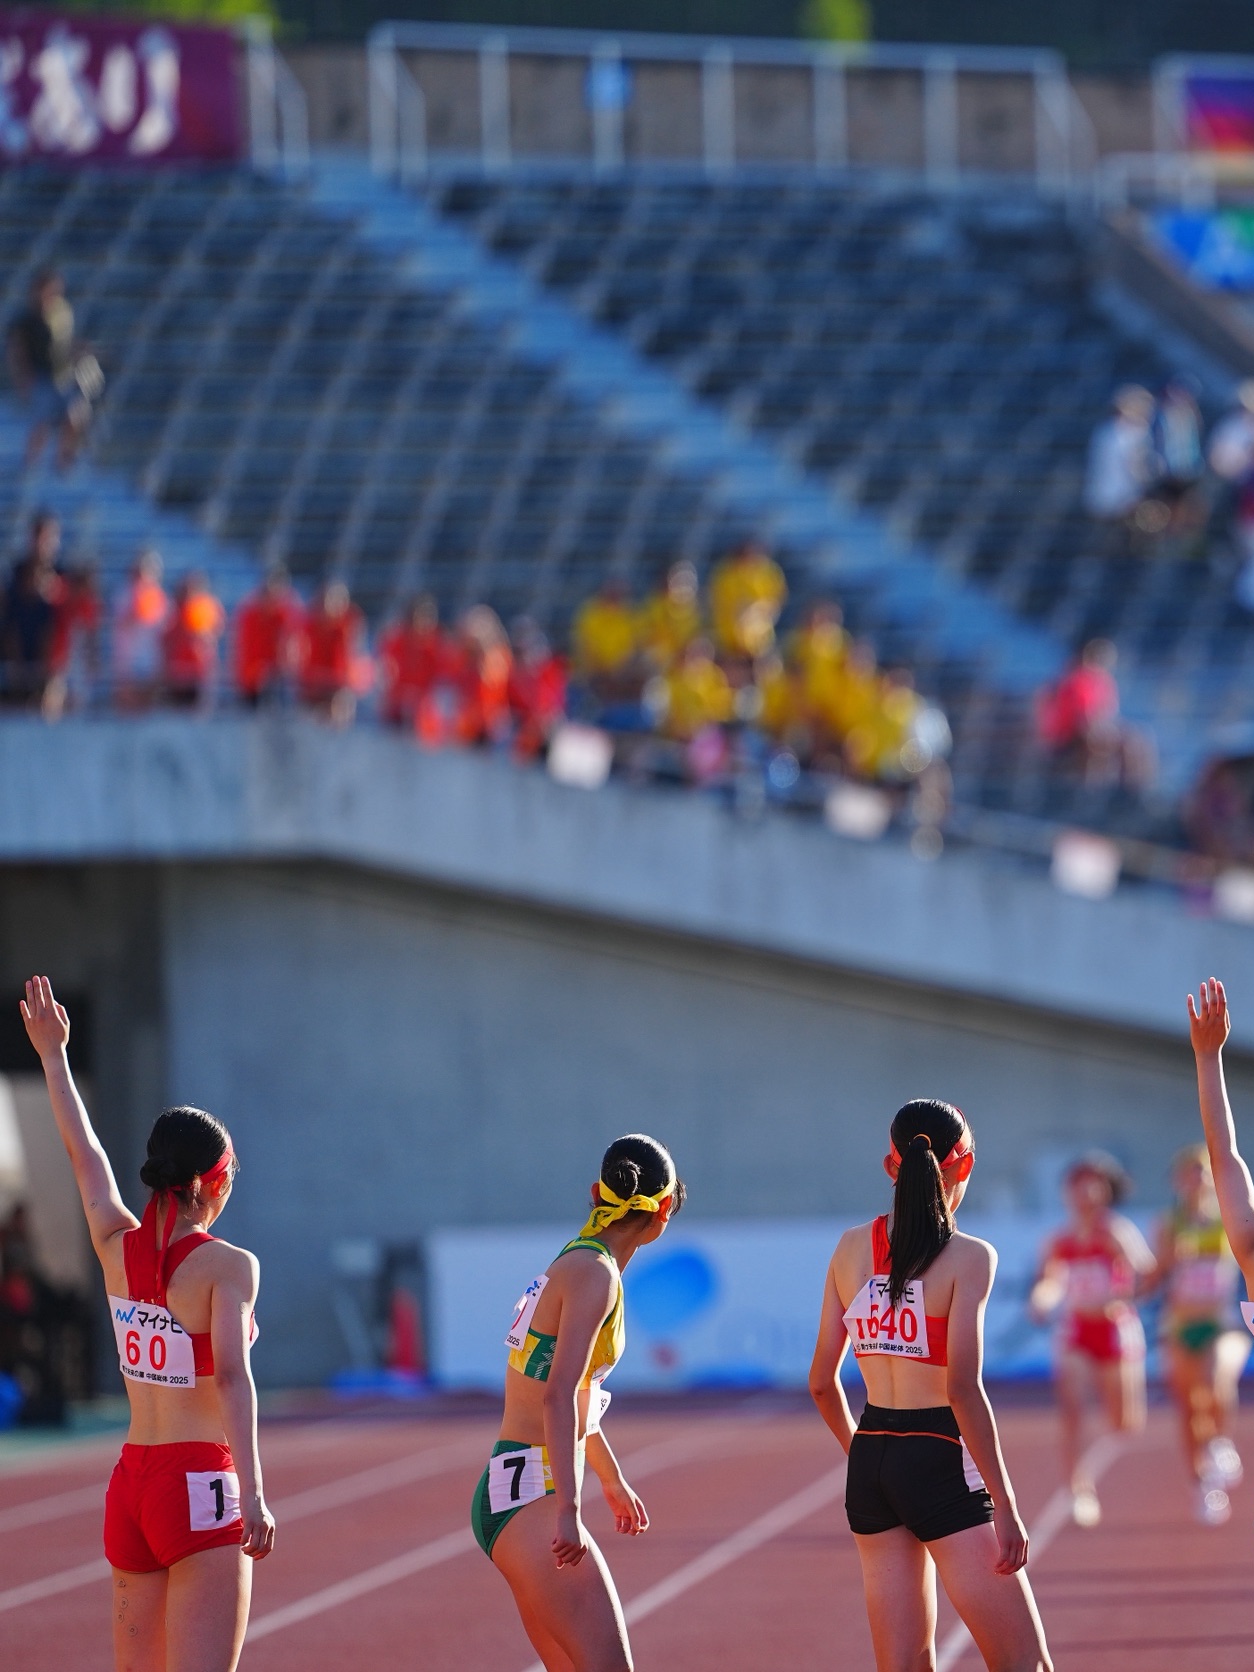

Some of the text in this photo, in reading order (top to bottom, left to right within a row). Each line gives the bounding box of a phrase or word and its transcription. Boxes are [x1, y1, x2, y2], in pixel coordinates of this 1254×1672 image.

[137, 1310, 183, 1334] マイナビ
[126, 1330, 167, 1371] 60
[506, 1334, 521, 1347] 2025
[905, 1345, 923, 1354] 2025
[169, 1375, 189, 1384] 2025
[503, 1456, 526, 1501] 7
[209, 1478, 225, 1521] 1
